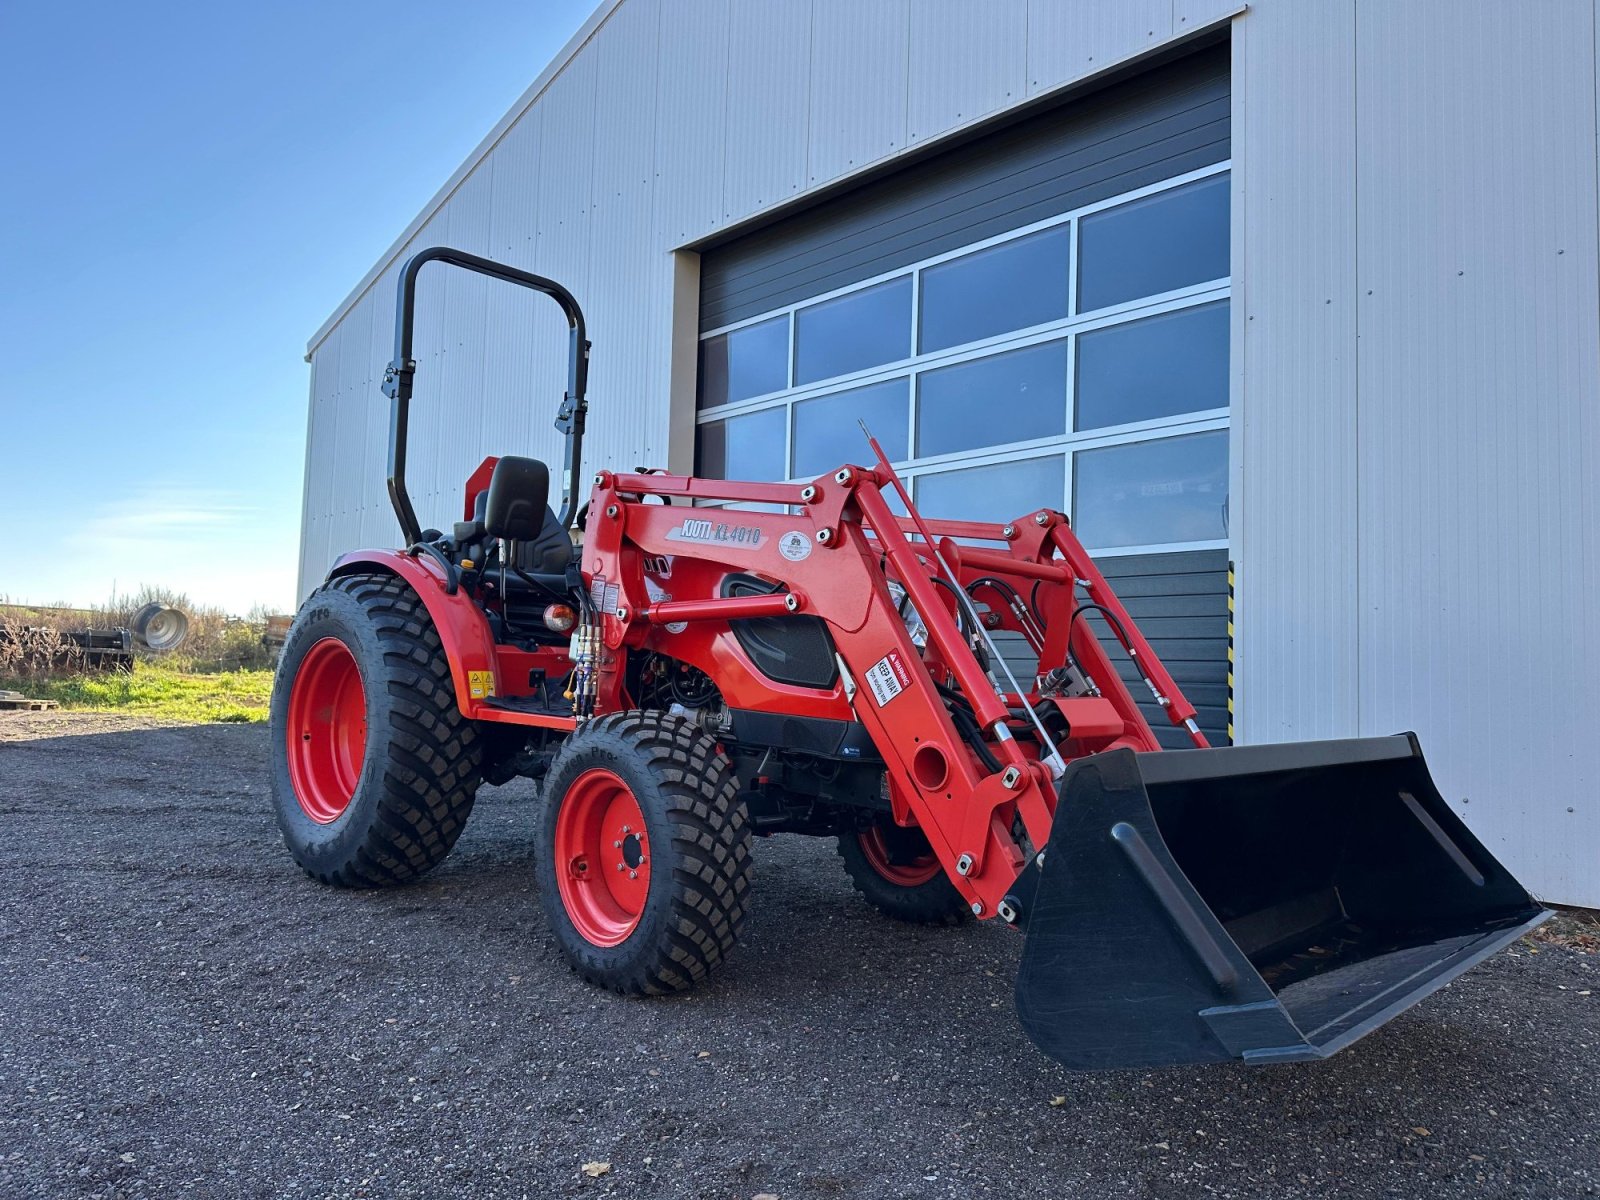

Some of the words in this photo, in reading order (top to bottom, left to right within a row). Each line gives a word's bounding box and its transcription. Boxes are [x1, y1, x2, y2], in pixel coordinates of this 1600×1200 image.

[680, 519, 713, 540] KIOTI
[877, 660, 890, 677] KEEP
[885, 677, 899, 696] AWAY
[894, 659, 910, 686] WARNING
